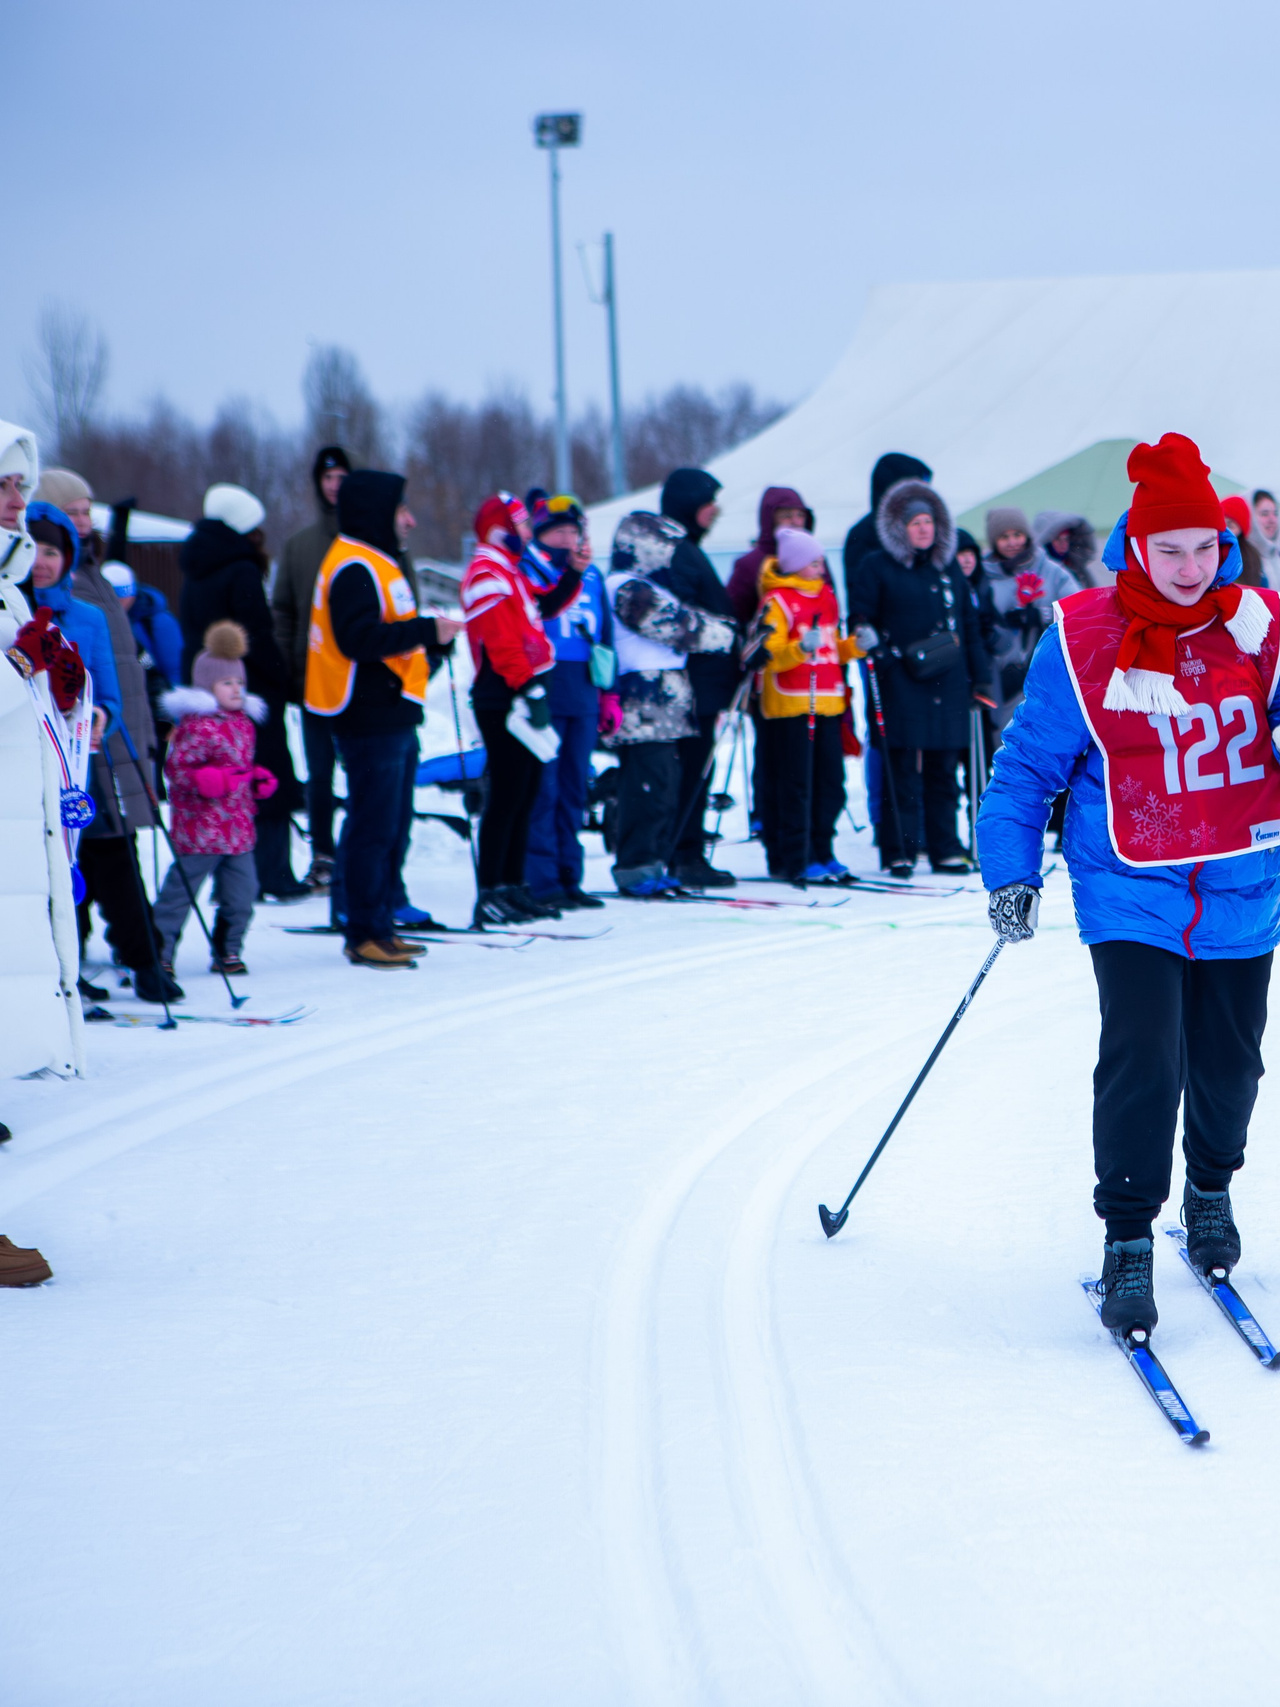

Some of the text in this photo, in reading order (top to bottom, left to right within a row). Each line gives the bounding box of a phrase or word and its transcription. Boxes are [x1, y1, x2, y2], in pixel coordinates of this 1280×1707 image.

[1181, 664, 1206, 677] ГЕРОЕВ
[1147, 695, 1265, 795] 122
[983, 947, 1001, 973] NORDWAY
[1155, 1391, 1191, 1422] NORDWAY
